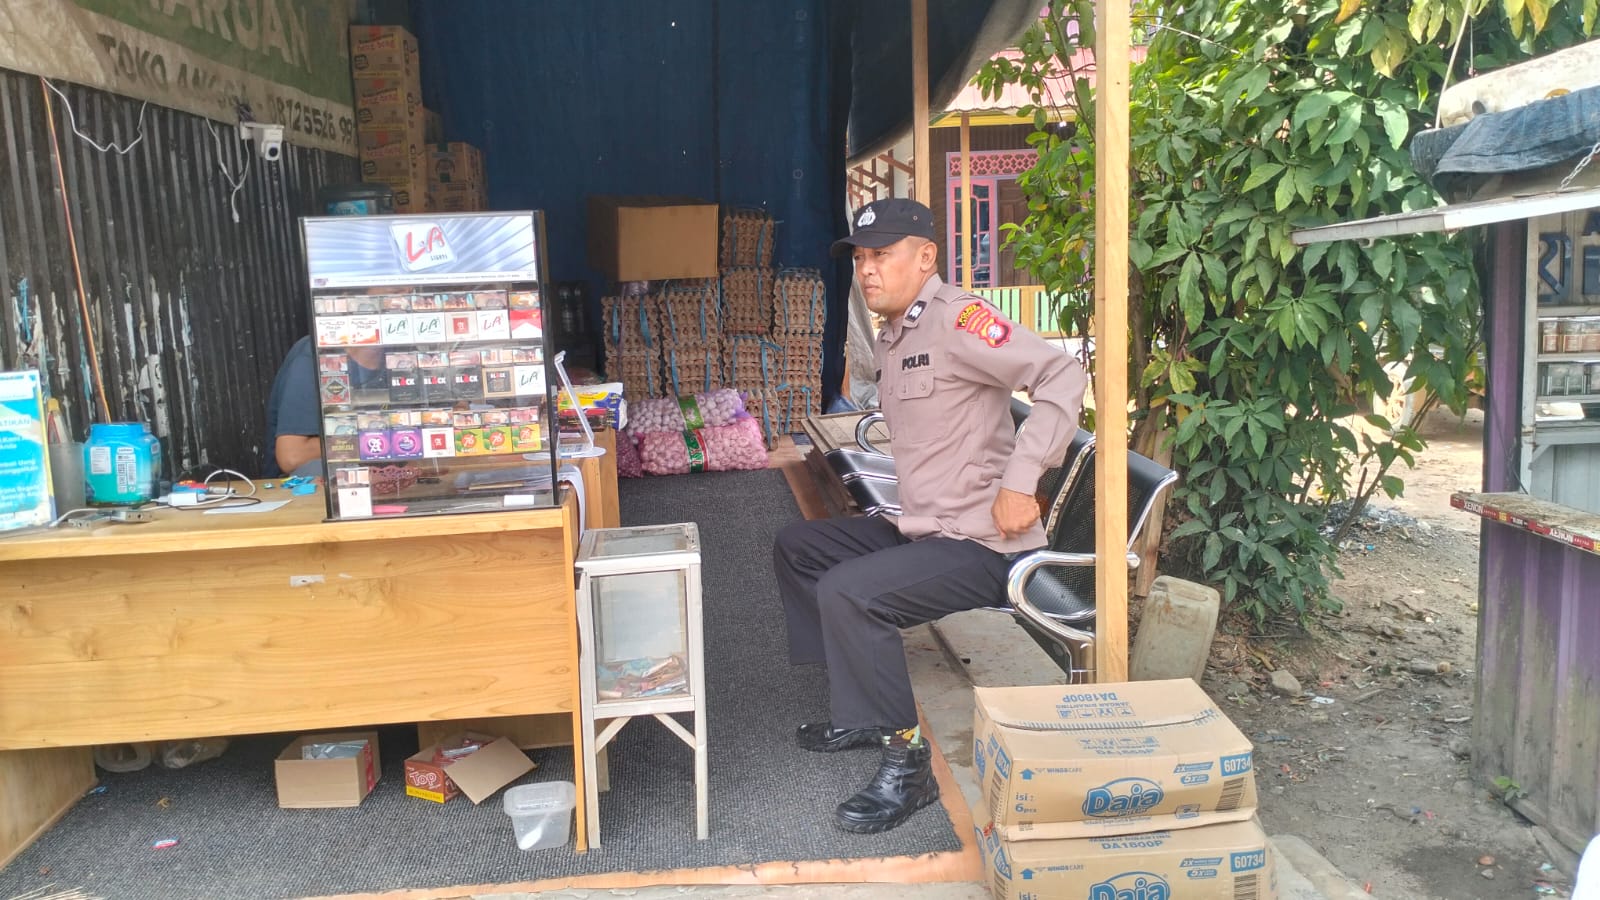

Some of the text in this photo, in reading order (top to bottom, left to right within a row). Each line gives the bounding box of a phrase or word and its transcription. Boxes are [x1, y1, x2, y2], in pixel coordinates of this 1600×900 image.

[96, 32, 168, 92] TOKO
[405, 226, 445, 263] LA
[388, 319, 406, 333] LA
[420, 317, 438, 333] LA
[483, 316, 501, 330] LA
[902, 353, 930, 371] POLRI
[520, 371, 538, 386] LA
[1464, 500, 1483, 514] XENON
[1549, 528, 1573, 543] XENON
[1062, 692, 1118, 703] DA1800P
[1224, 756, 1251, 773] 60734
[410, 771, 437, 787] Top
[1084, 783, 1163, 816] Daia
[1234, 854, 1265, 869] 60734
